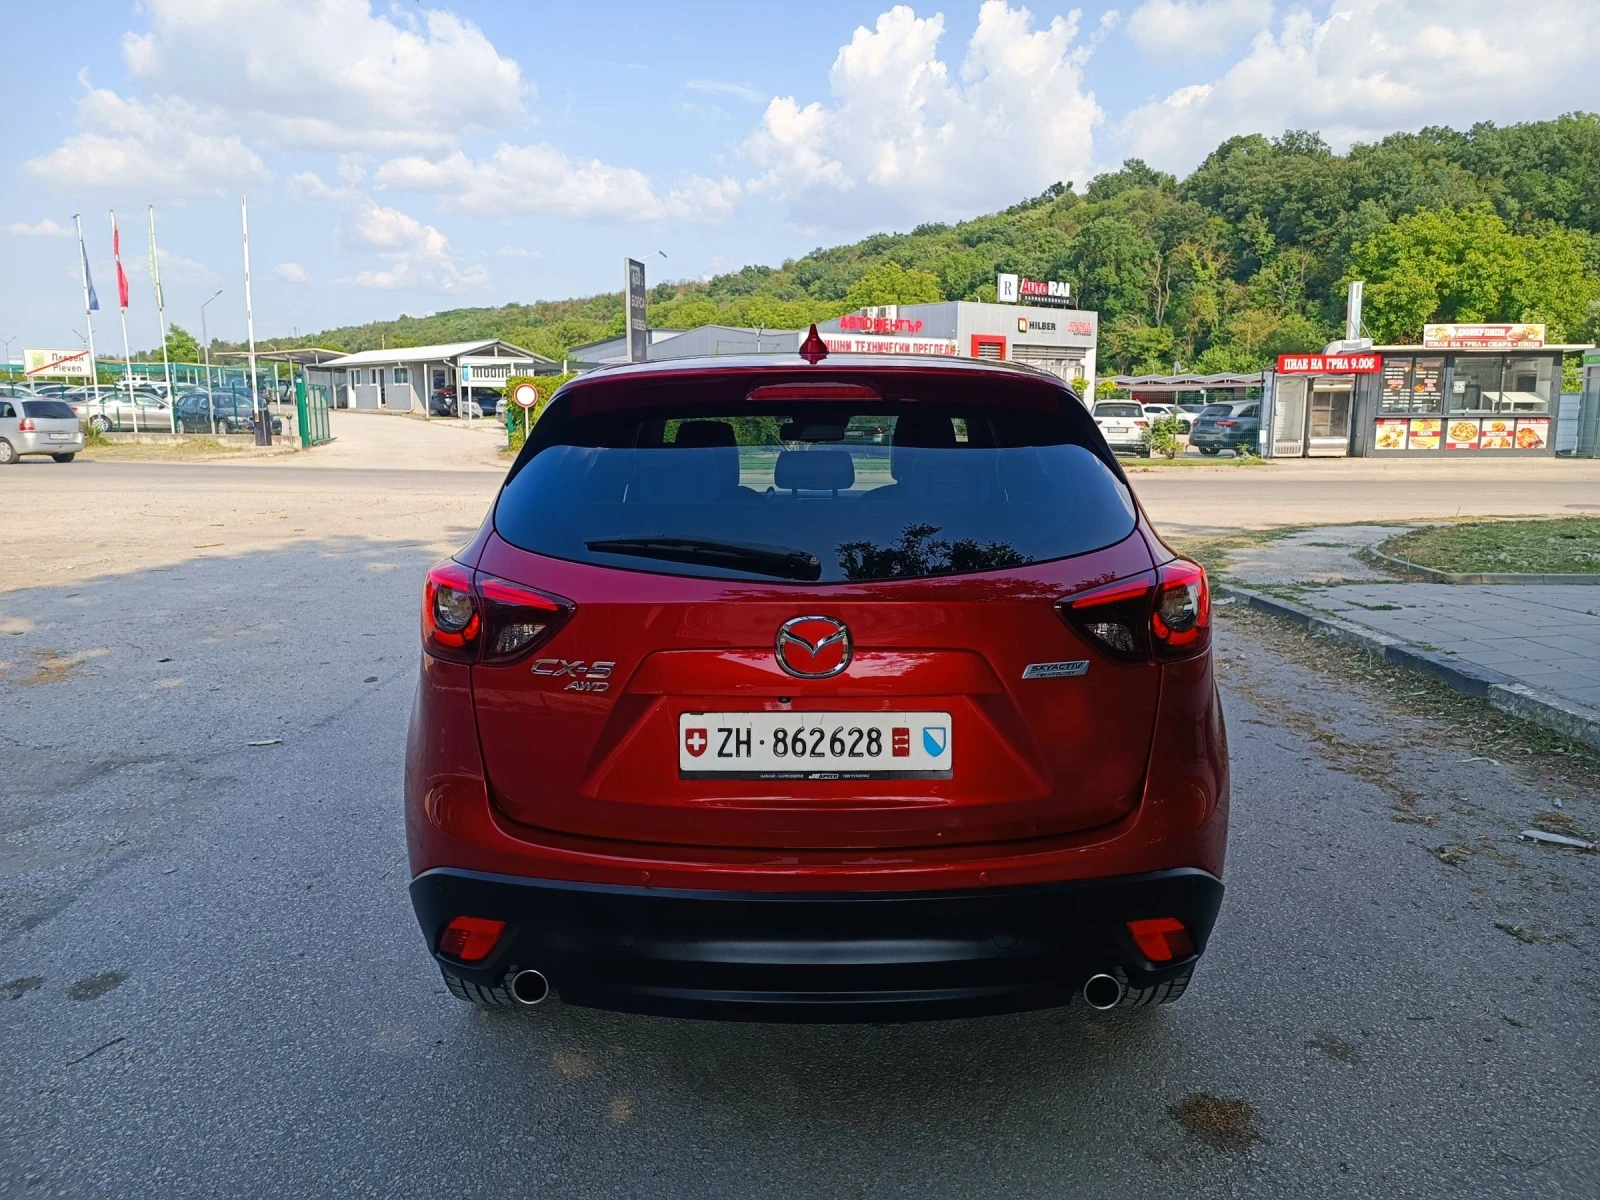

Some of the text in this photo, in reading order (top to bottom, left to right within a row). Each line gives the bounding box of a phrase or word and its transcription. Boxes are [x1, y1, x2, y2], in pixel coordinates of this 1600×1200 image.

[1004, 280, 1012, 295] R
[840, 314, 922, 333] АВТОЦЕНТЪР
[1029, 321, 1056, 331] HILBER
[855, 340, 910, 354] ТЕХНИЧЕСКИ
[53, 364, 82, 372] Pleven
[1284, 358, 1375, 370] ПИЛЕ НА ГРИЛ 9.00€
[531, 659, 616, 678] CX-5
[1030, 662, 1083, 672] SKYACTIV
[1036, 670, 1076, 678] TECHNOLOGY
[564, 681, 609, 692] AWD
